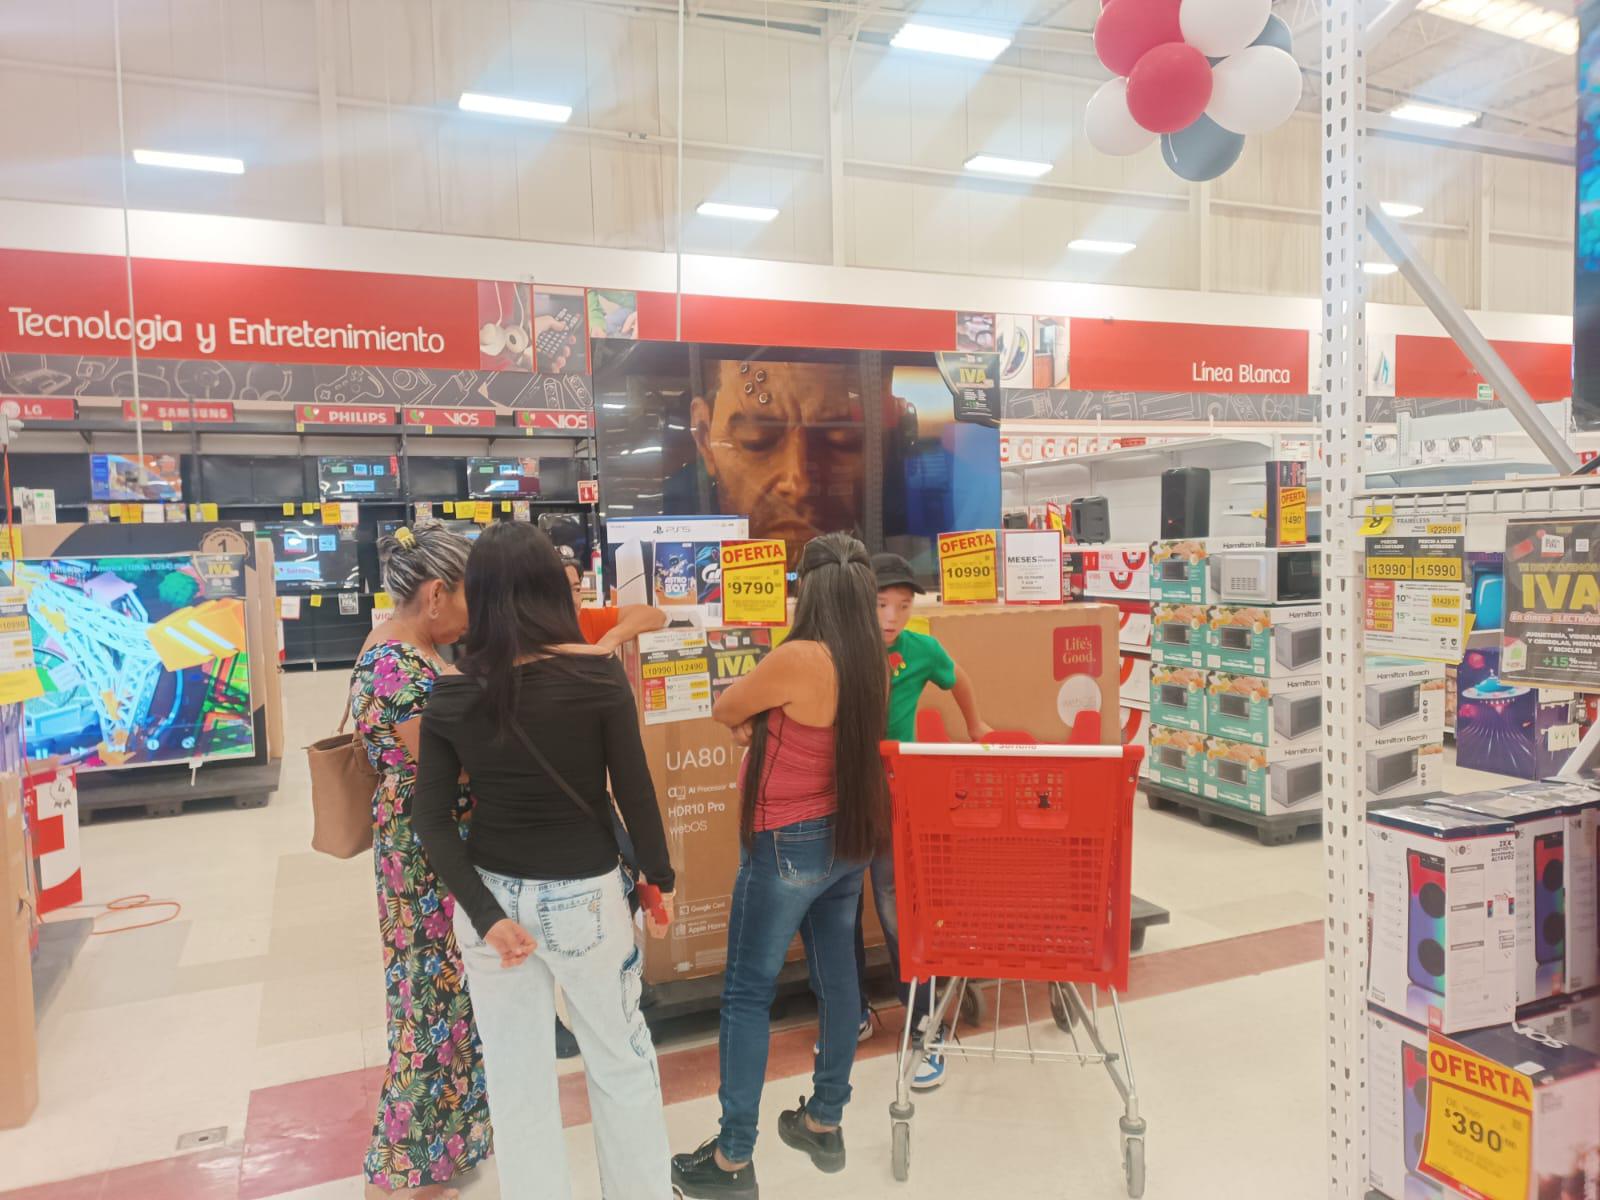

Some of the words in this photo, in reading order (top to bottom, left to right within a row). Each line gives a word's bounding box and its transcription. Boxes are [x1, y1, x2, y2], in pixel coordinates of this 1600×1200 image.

[197, 320, 216, 354] y
[228, 317, 445, 354] Entretenimiento
[960, 367, 987, 384] IVA
[1192, 361, 1233, 382] Línea
[1239, 363, 1291, 384] Blanca
[24, 404, 43, 416] LG
[328, 411, 388, 424] PHILIPS
[443, 412, 480, 425] VIOS
[545, 414, 588, 429] VIOS
[1281, 491, 1305, 504] OFERTA
[940, 535, 994, 554] OFERTA
[722, 544, 784, 565] OFERTA
[208, 564, 233, 575] IVA
[947, 566, 990, 579] 10990
[665, 584, 687, 592] BOT
[1522, 574, 1600, 610] IVA
[1065, 637, 1092, 651] Life's
[1062, 651, 1096, 665] Good.
[717, 655, 757, 678] IVA
[1376, 671, 1407, 680] Hamilton
[1408, 669, 1430, 678] Beach
[1287, 680, 1320, 689] Hamilton
[1375, 736, 1406, 746] Hamilton
[666, 746, 726, 771] UA80
[668, 803, 704, 818] HDR10
[707, 801, 726, 813] Pro
[670, 820, 708, 835] webOS
[690, 903, 712, 913] Google
[1430, 1049, 1530, 1103] OFERTA
